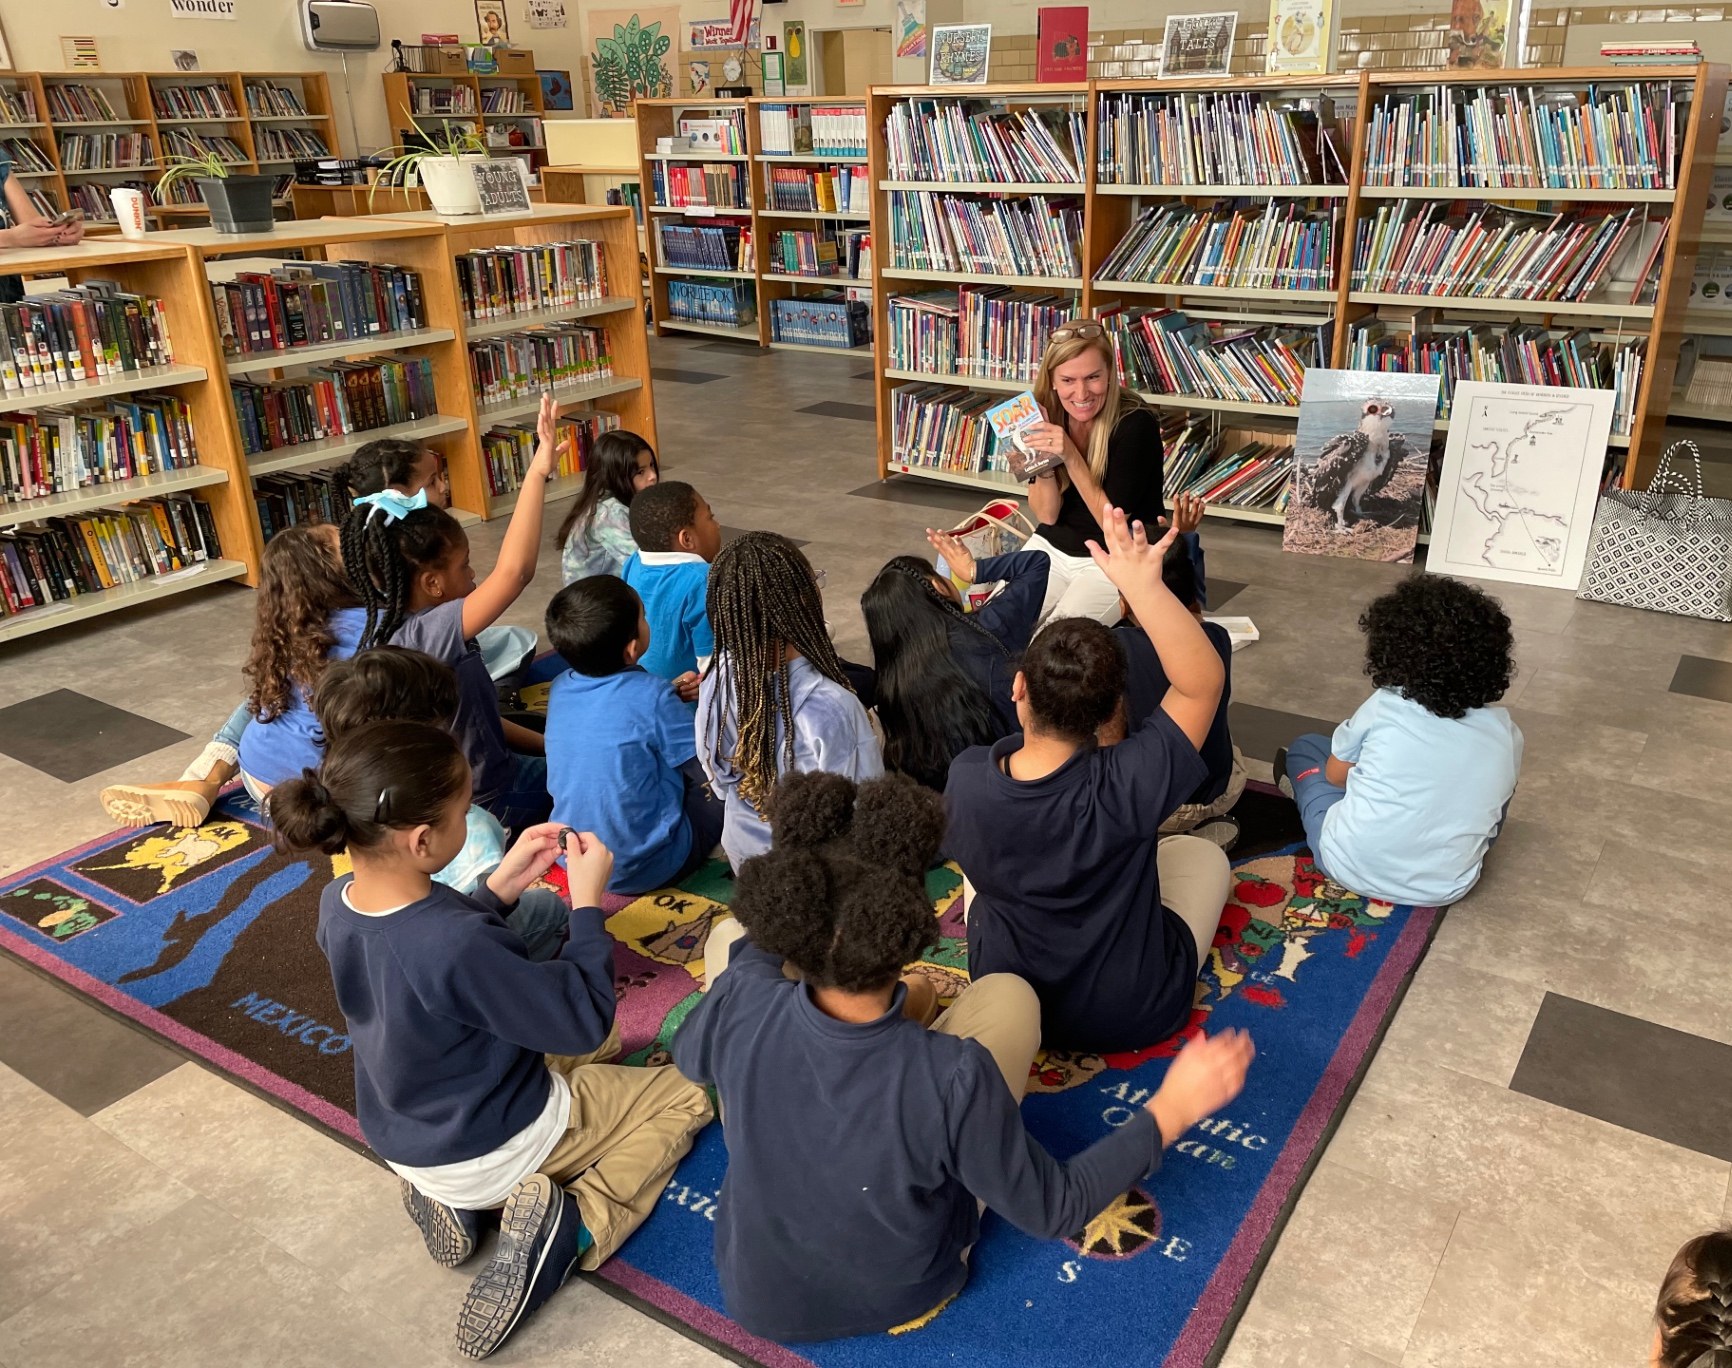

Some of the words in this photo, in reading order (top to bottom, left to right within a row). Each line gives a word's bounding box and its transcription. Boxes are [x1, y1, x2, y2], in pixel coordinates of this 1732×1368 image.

[1180, 37, 1216, 50] TALES
[477, 170, 518, 185] YOUNG
[484, 190, 525, 206] ADULTS
[992, 395, 1036, 434] SOAR
[207, 825, 239, 840] AK
[653, 894, 693, 914] OK
[229, 992, 352, 1054] MEXICO
[1160, 1235, 1192, 1262] E
[1057, 1261, 1081, 1283] S
